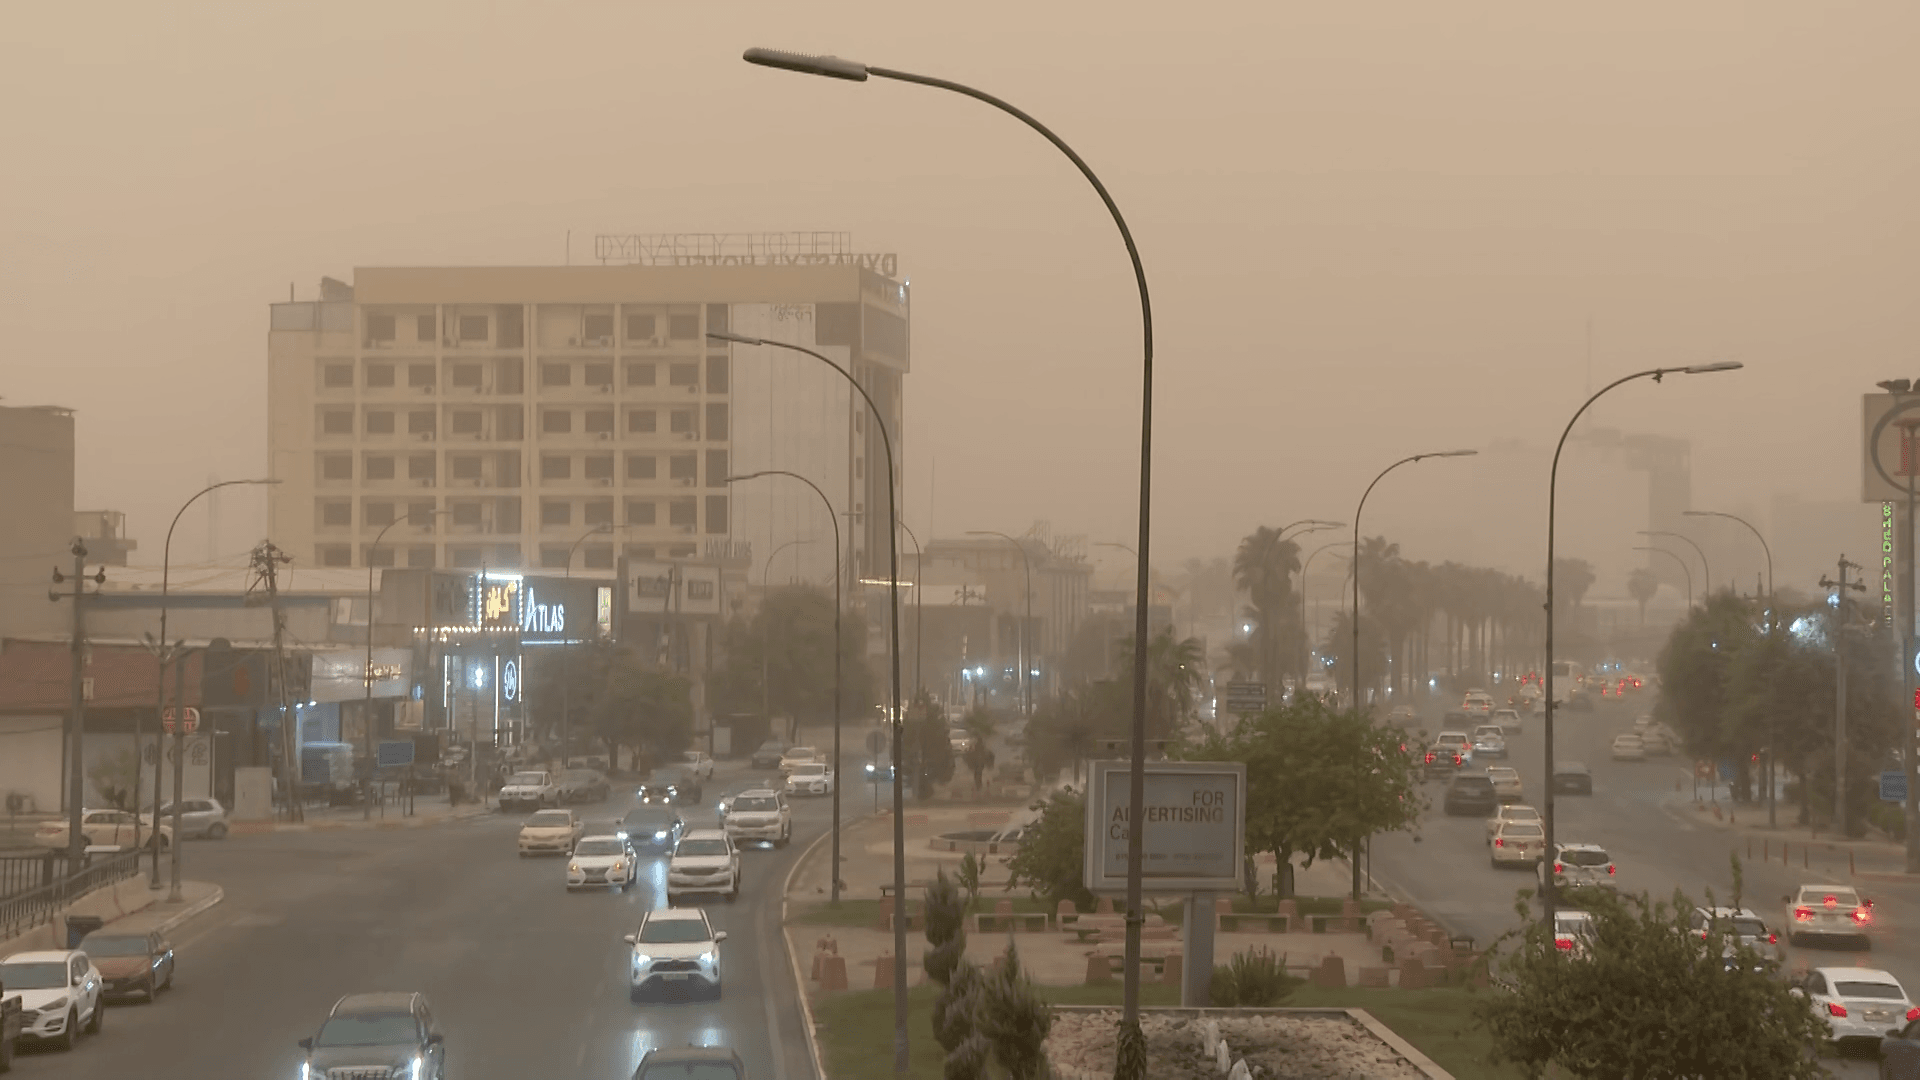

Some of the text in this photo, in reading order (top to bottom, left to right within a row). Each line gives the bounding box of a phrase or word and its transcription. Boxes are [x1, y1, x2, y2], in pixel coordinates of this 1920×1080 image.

[596, 234, 727, 257] DYNASTY
[524, 587, 564, 631] ATLAS
[1193, 790, 1224, 806] FOR
[1112, 806, 1224, 823] AVERTISING
